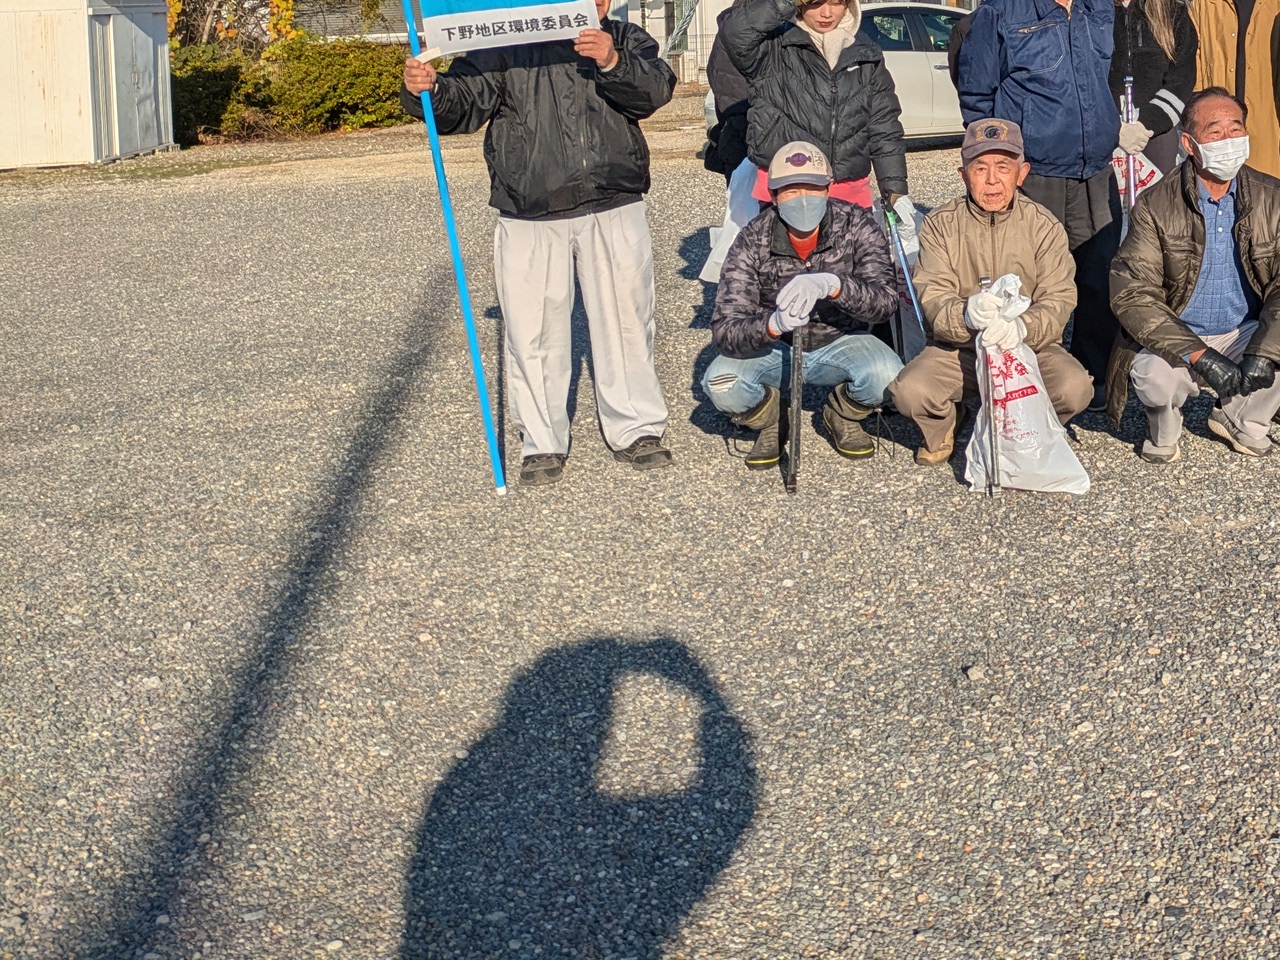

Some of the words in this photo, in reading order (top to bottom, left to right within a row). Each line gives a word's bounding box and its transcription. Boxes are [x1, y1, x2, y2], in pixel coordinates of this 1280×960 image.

[441, 13, 589, 41] 下野地区環境委員会
